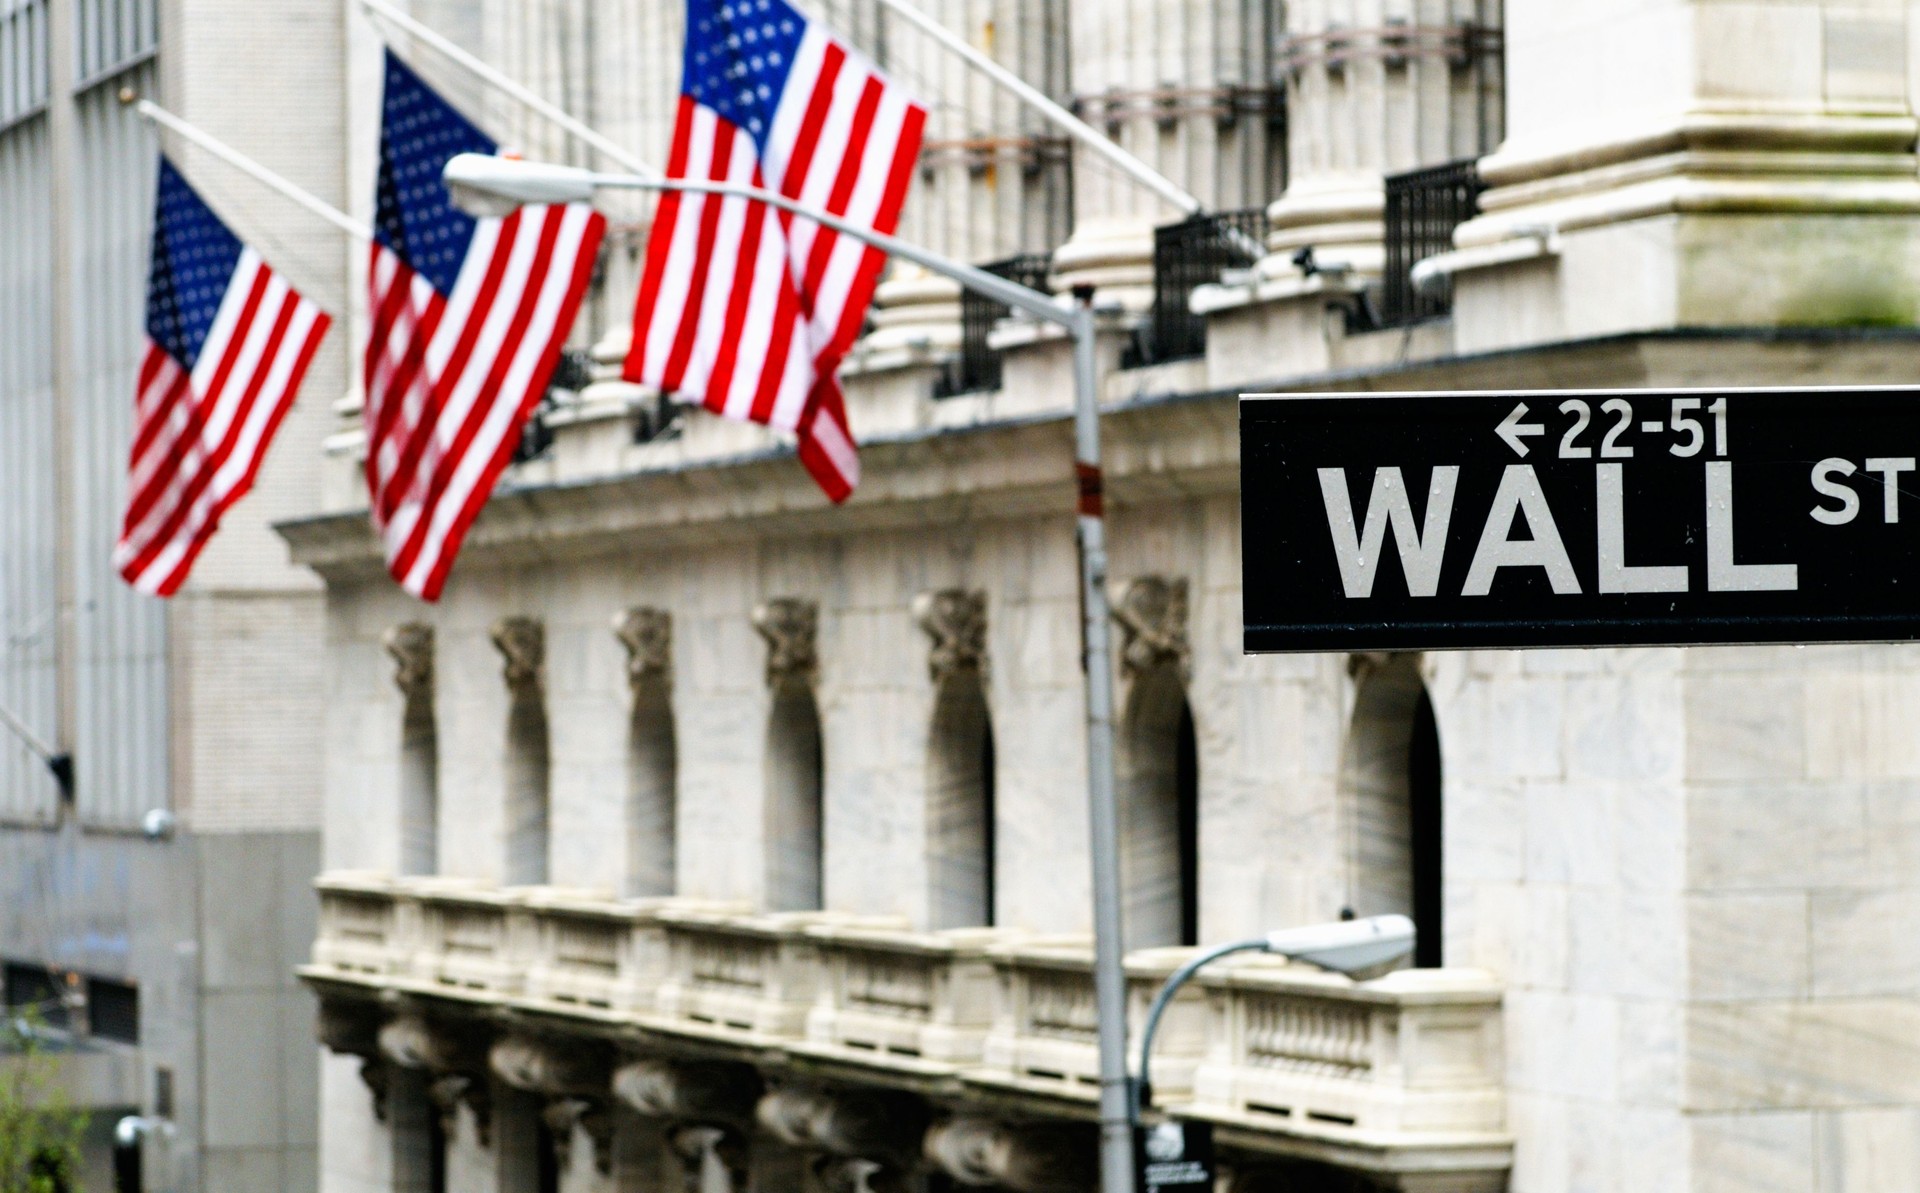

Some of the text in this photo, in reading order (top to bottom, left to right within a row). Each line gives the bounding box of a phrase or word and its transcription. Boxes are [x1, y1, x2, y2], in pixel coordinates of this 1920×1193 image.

[1558, 398, 1728, 459] 22-51
[1317, 457, 1916, 598] WALL ST
